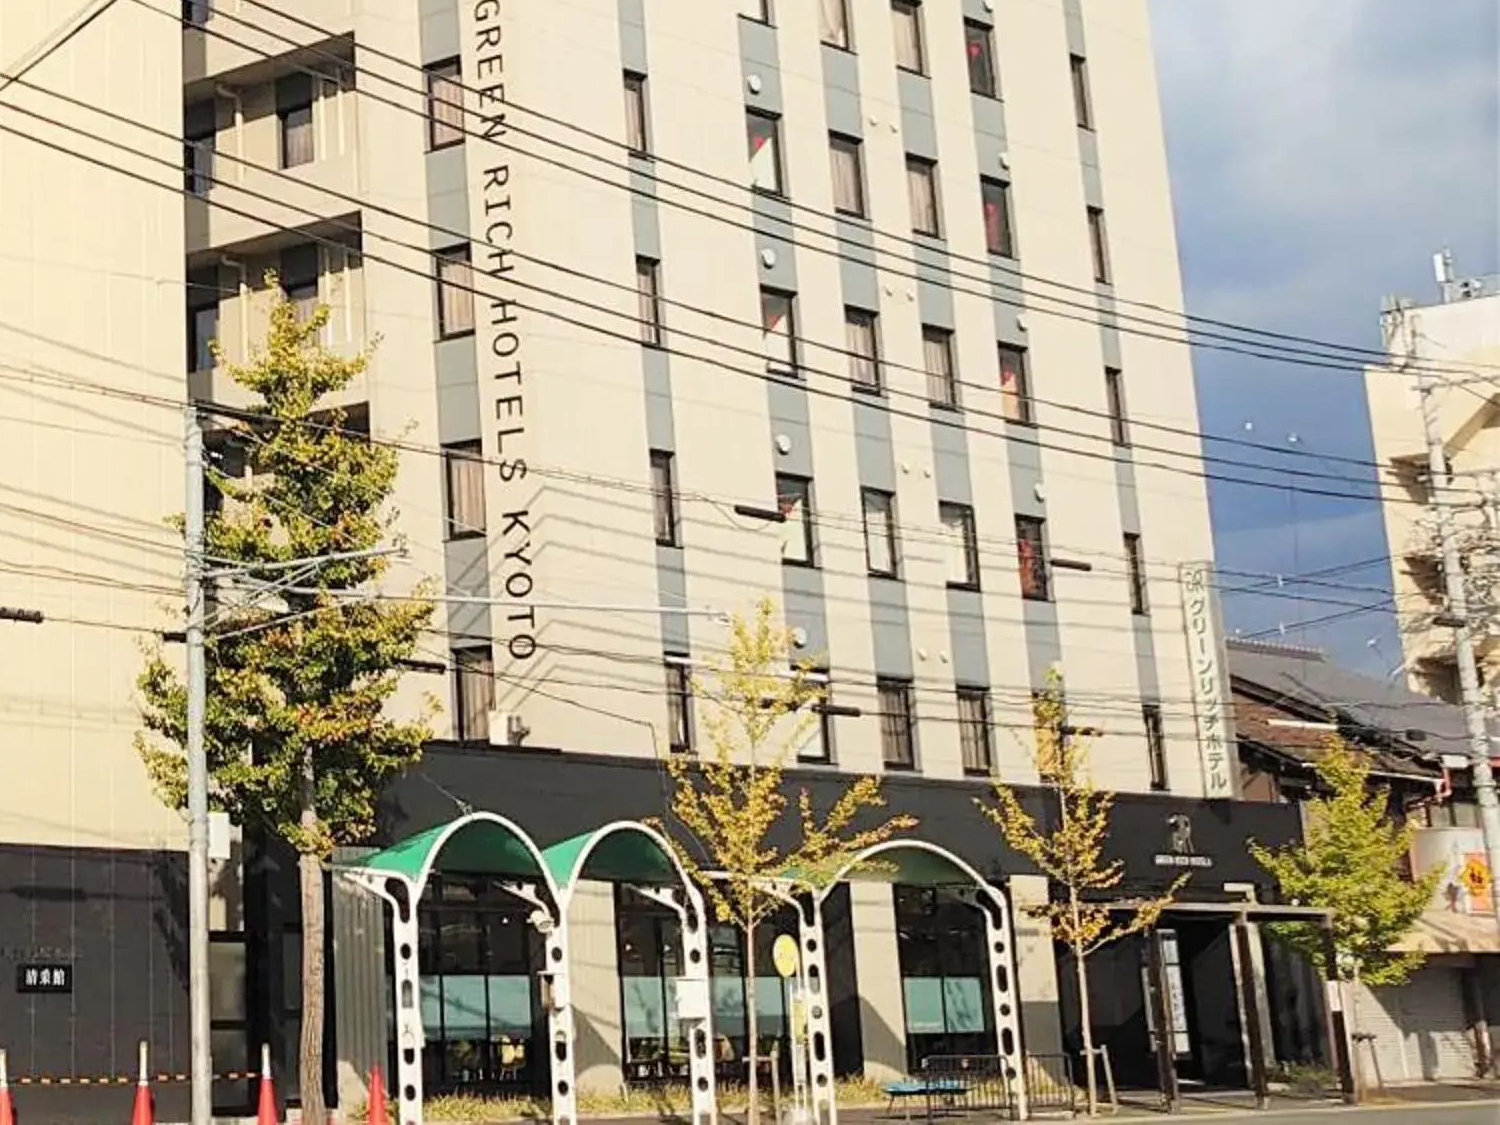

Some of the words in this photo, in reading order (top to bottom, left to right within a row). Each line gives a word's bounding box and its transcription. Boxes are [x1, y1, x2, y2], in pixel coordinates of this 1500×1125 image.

[482, 164, 515, 277] RICH
[490, 298, 528, 483] HOTELS
[501, 510, 537, 660] KYOTO
